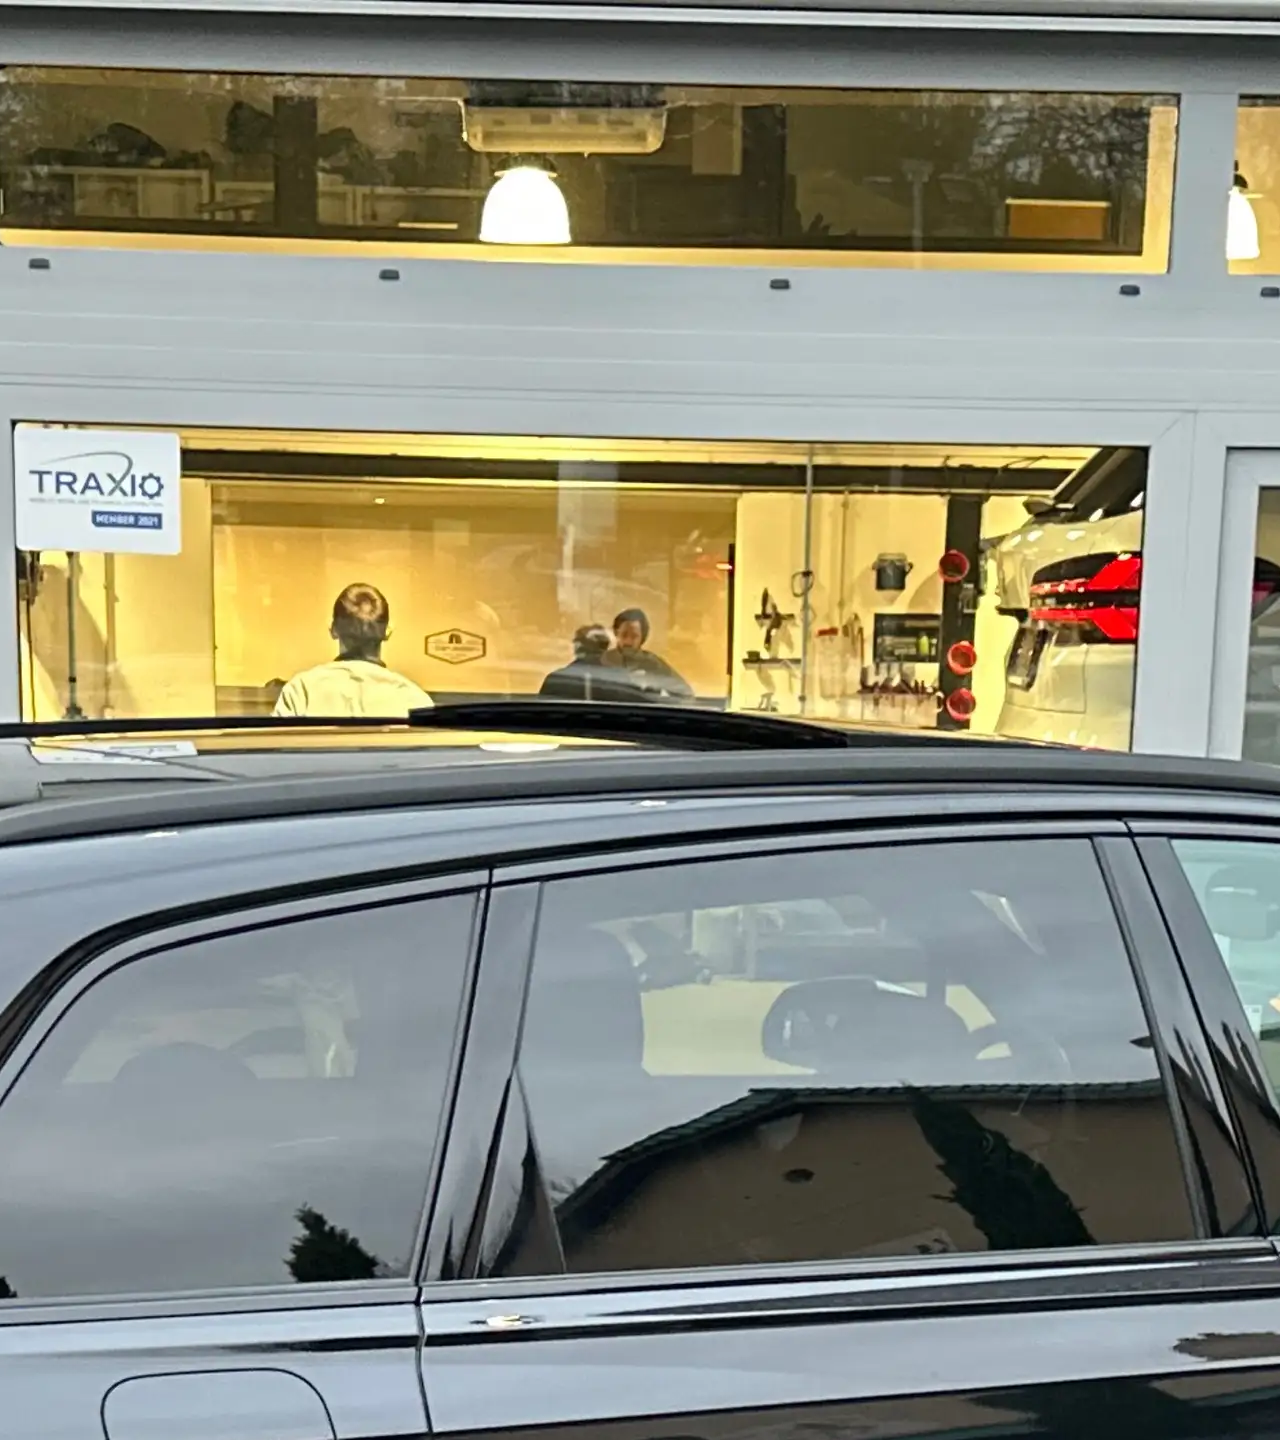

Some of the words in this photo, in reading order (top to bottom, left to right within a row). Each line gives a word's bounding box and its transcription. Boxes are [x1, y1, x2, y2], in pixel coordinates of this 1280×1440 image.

[29, 469, 164, 499] TRAXIO
[95, 513, 136, 526] MEMBER
[138, 515, 159, 527] 2021
